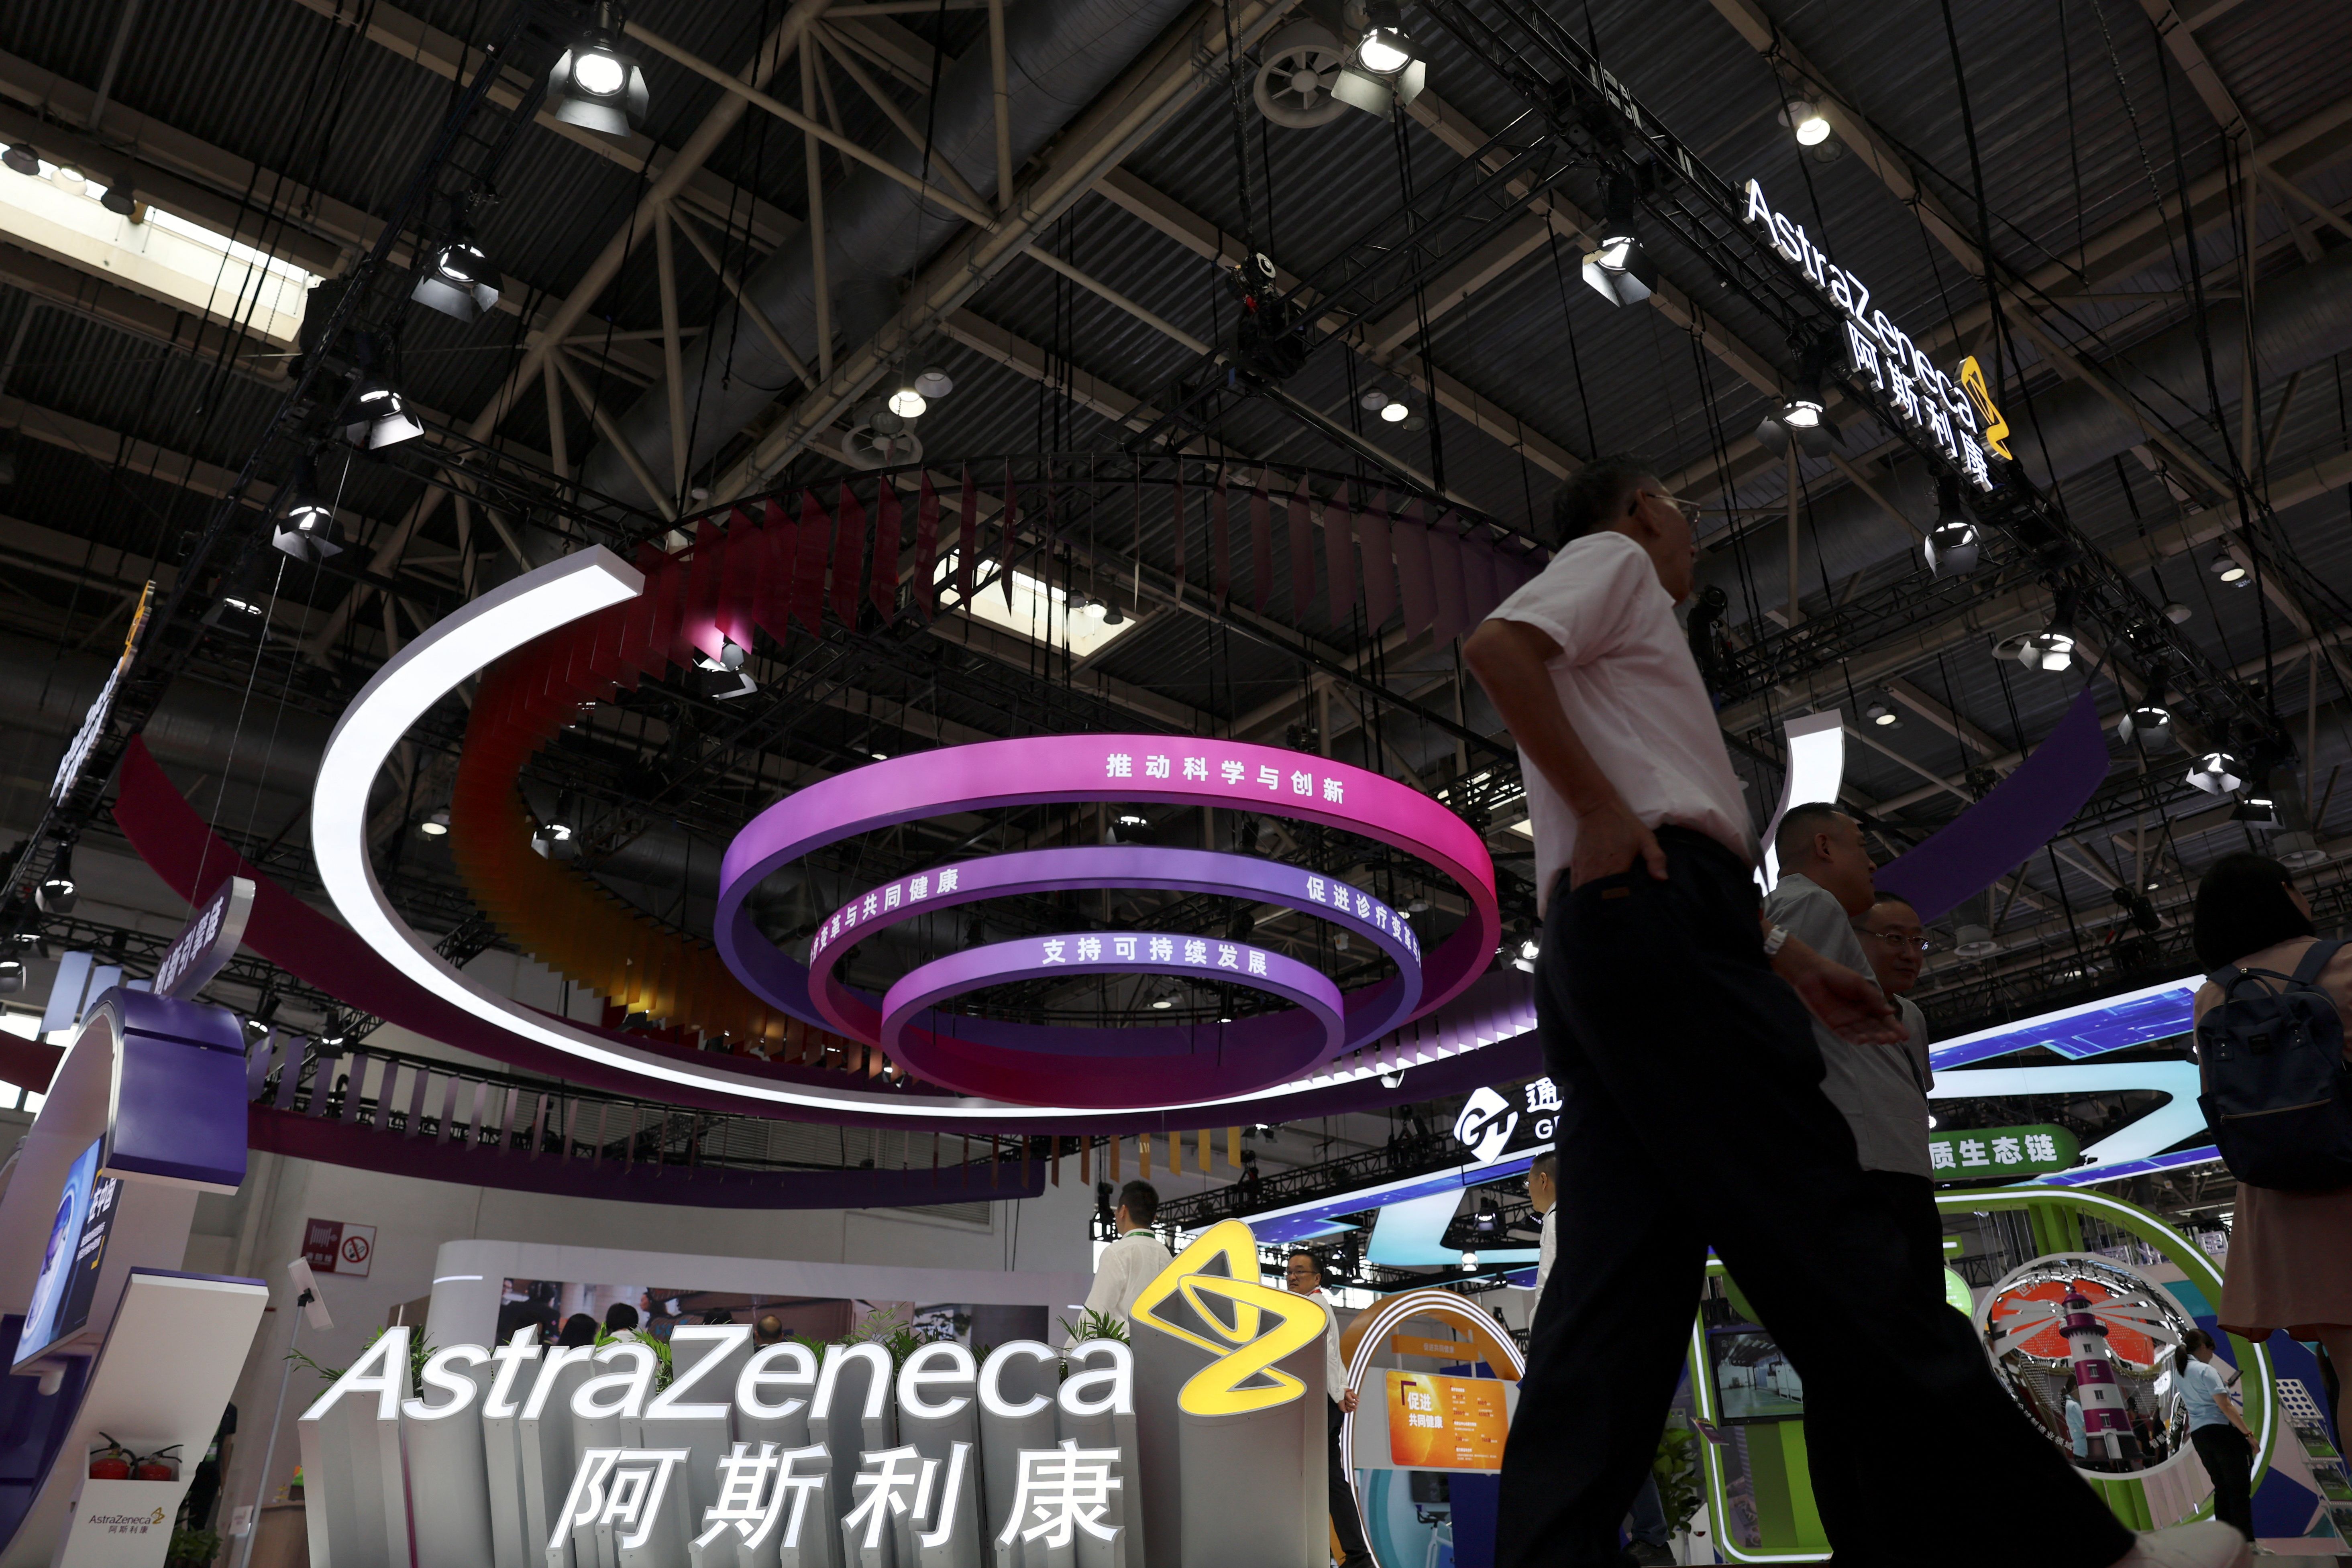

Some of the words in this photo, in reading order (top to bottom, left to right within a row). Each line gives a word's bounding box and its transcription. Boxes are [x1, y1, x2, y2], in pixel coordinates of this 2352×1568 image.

[1747, 178, 1977, 434] AstraZeneca
[1847, 320, 1993, 491] 阿斯利康
[1105, 753, 1344, 804] 推动科学与创新
[809, 868, 958, 970] 疗变革与共同健康
[1306, 876, 1421, 968] 促进诊疗变革与
[1042, 937, 1268, 976] 支持可持续发展
[1928, 1134, 2058, 1170] 质生态链
[298, 1323, 1135, 1421] AstraZeneca
[1407, 1392, 1432, 1411] 促进
[1409, 1413, 1443, 1429] 共同健康
[89, 1515, 151, 1524] AstraZeneca
[547, 1438, 1123, 1551] 阿斯利康
[108, 1525, 149, 1534] 阿斯利康
